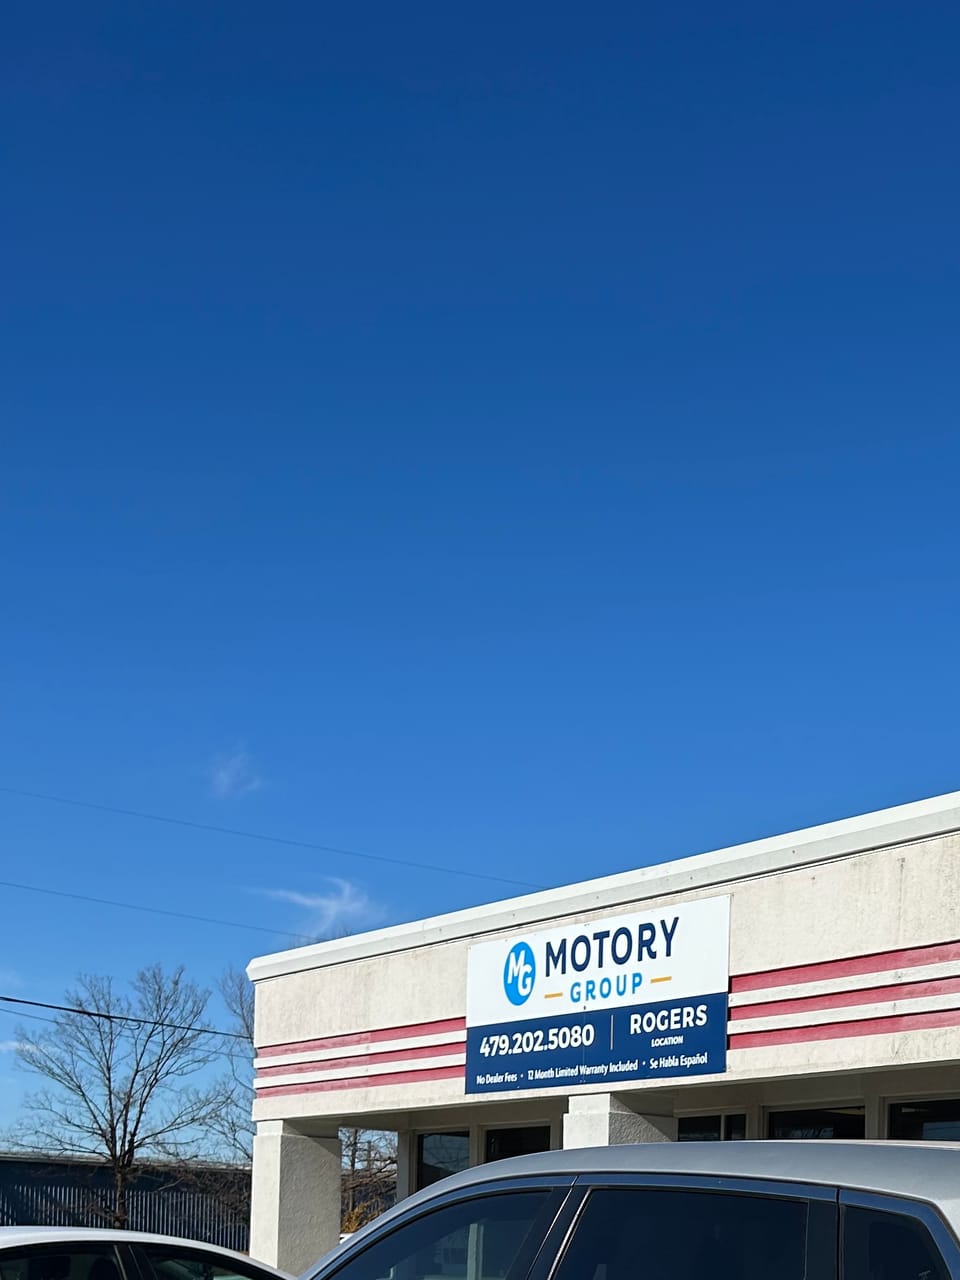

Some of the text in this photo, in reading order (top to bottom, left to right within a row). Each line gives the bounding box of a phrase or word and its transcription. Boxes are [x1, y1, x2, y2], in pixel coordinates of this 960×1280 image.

[545, 916, 679, 977] MOTORY
[507, 949, 532, 998] MG
[570, 972, 643, 1003] GROUP
[630, 1004, 708, 1035] ROGERS
[479, 1024, 595, 1057] 479.202.5080
[651, 1035, 684, 1047] LOCATION
[476, 1051, 708, 1085] No Dealer Fees 12 Month Limited Warranty Included Se Habla Español
